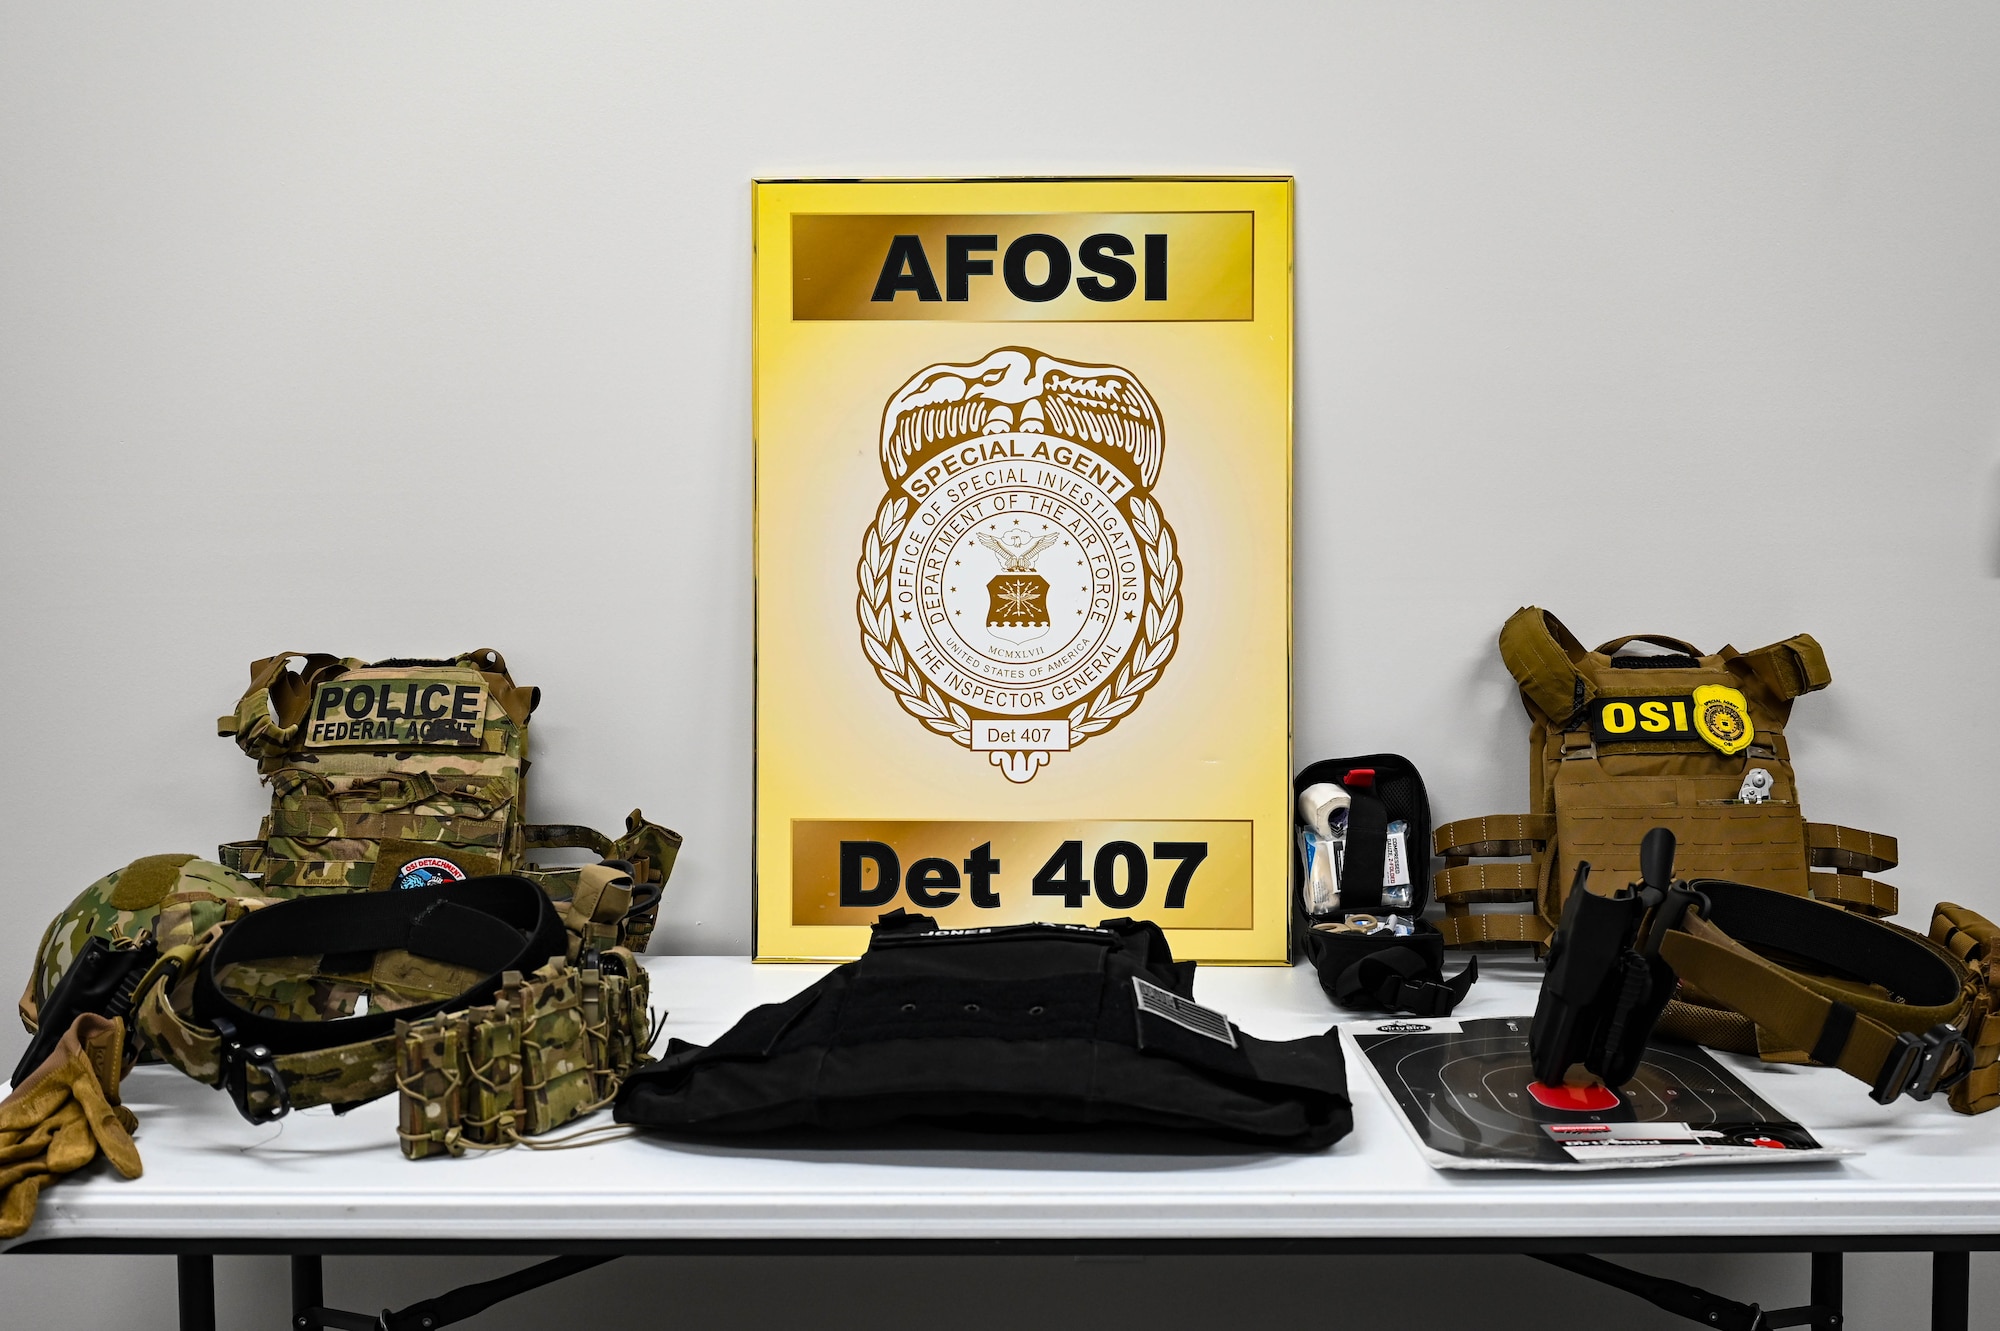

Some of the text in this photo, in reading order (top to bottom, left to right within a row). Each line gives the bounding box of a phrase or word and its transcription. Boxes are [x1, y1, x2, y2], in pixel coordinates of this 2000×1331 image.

[870, 233, 1168, 302] AFOSI
[911, 439, 1126, 498] SPECIAL AGENT
[898, 468, 1137, 603] OFFICE OF SPECIAL INVESTIGATIONS
[924, 494, 1111, 625] DEPARTMENT OF THE AIR FORCE
[945, 637, 1091, 678] UNITED STATES OF AMERICA
[988, 645, 1045, 659] MCMXLVII
[915, 641, 1122, 708] THE INSPECTOR GENERAL
[316, 683, 481, 721] POLICE
[1601, 701, 1689, 734] OSI
[312, 720, 476, 742] FEDERAL AGNT
[988, 728, 1051, 743] Det 407
[405, 859, 463, 879] OSI DETACHMENT
[840, 841, 1208, 909] Det 407
[1392, 837, 1400, 874] COMPRESSED
